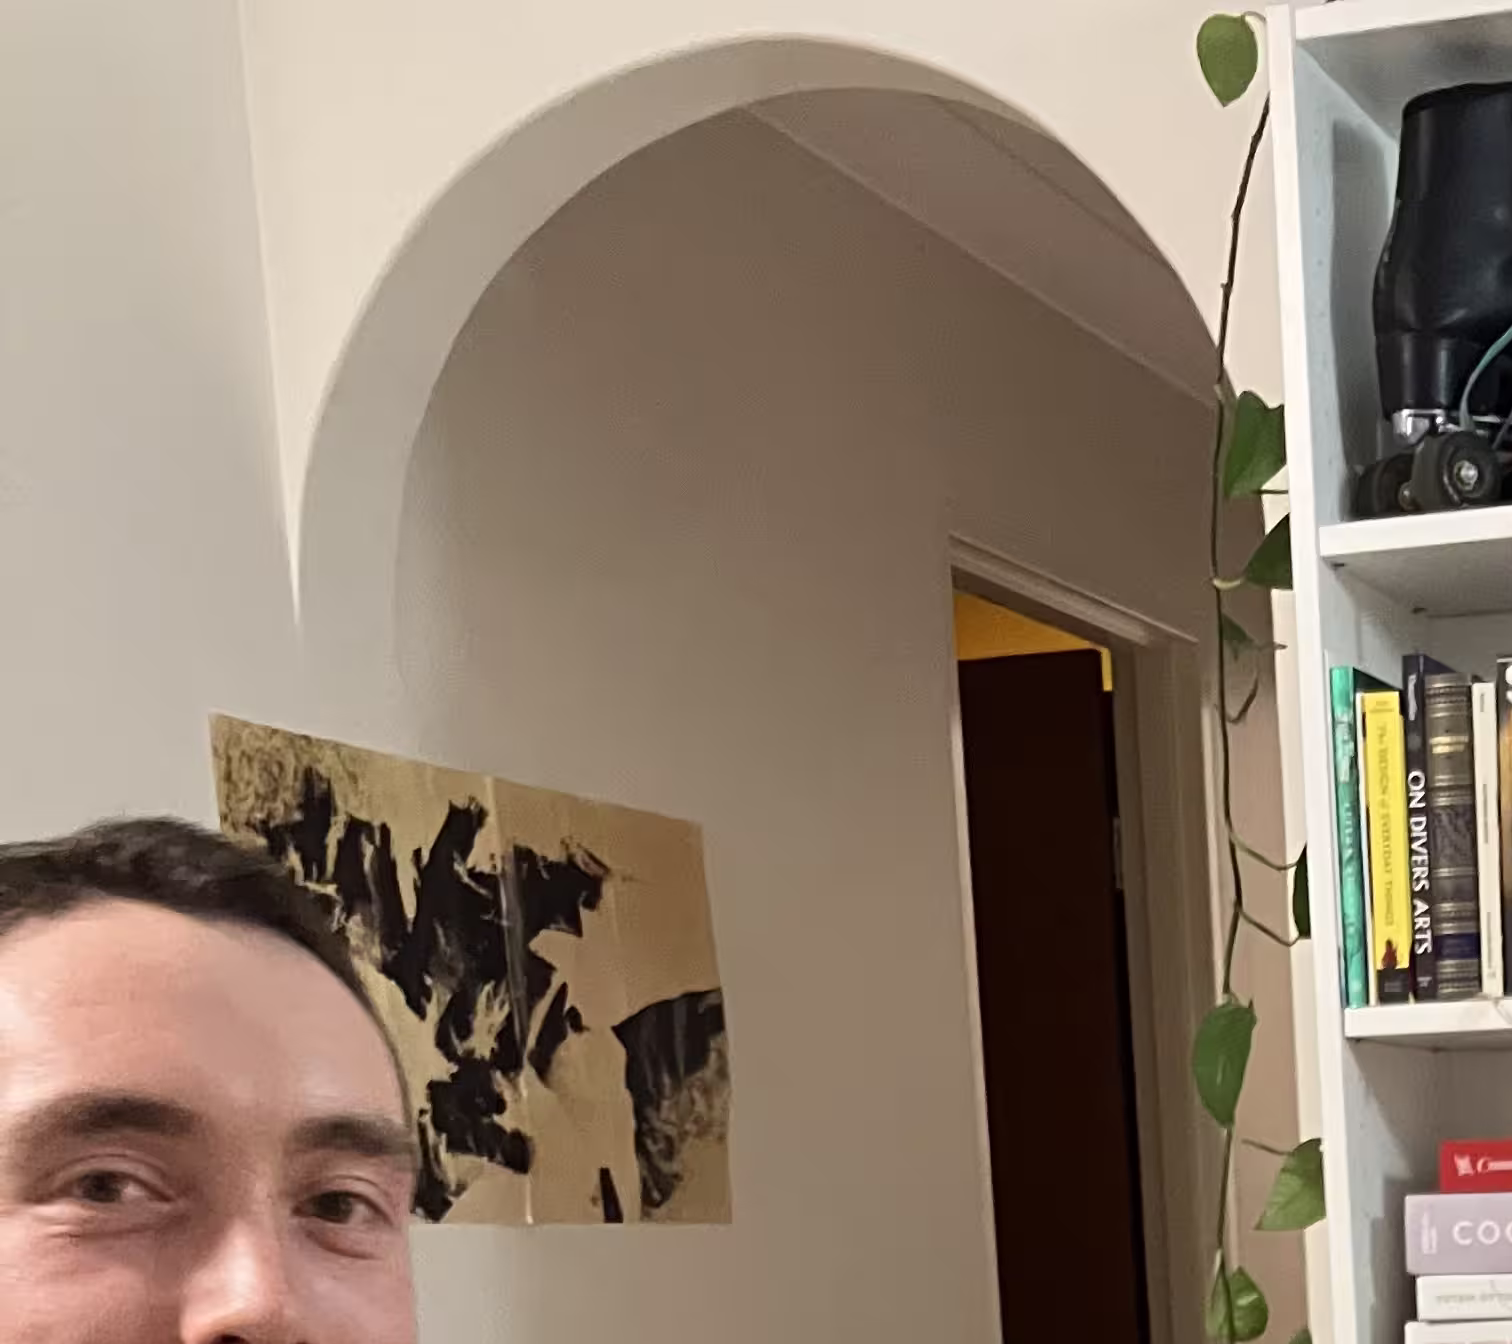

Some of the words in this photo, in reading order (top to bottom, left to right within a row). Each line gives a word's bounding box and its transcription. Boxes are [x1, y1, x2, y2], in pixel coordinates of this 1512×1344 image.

[1407, 771, 1426, 809] ON
[1409, 816, 1430, 891] DIVERS
[1413, 899, 1432, 955] ARTS
